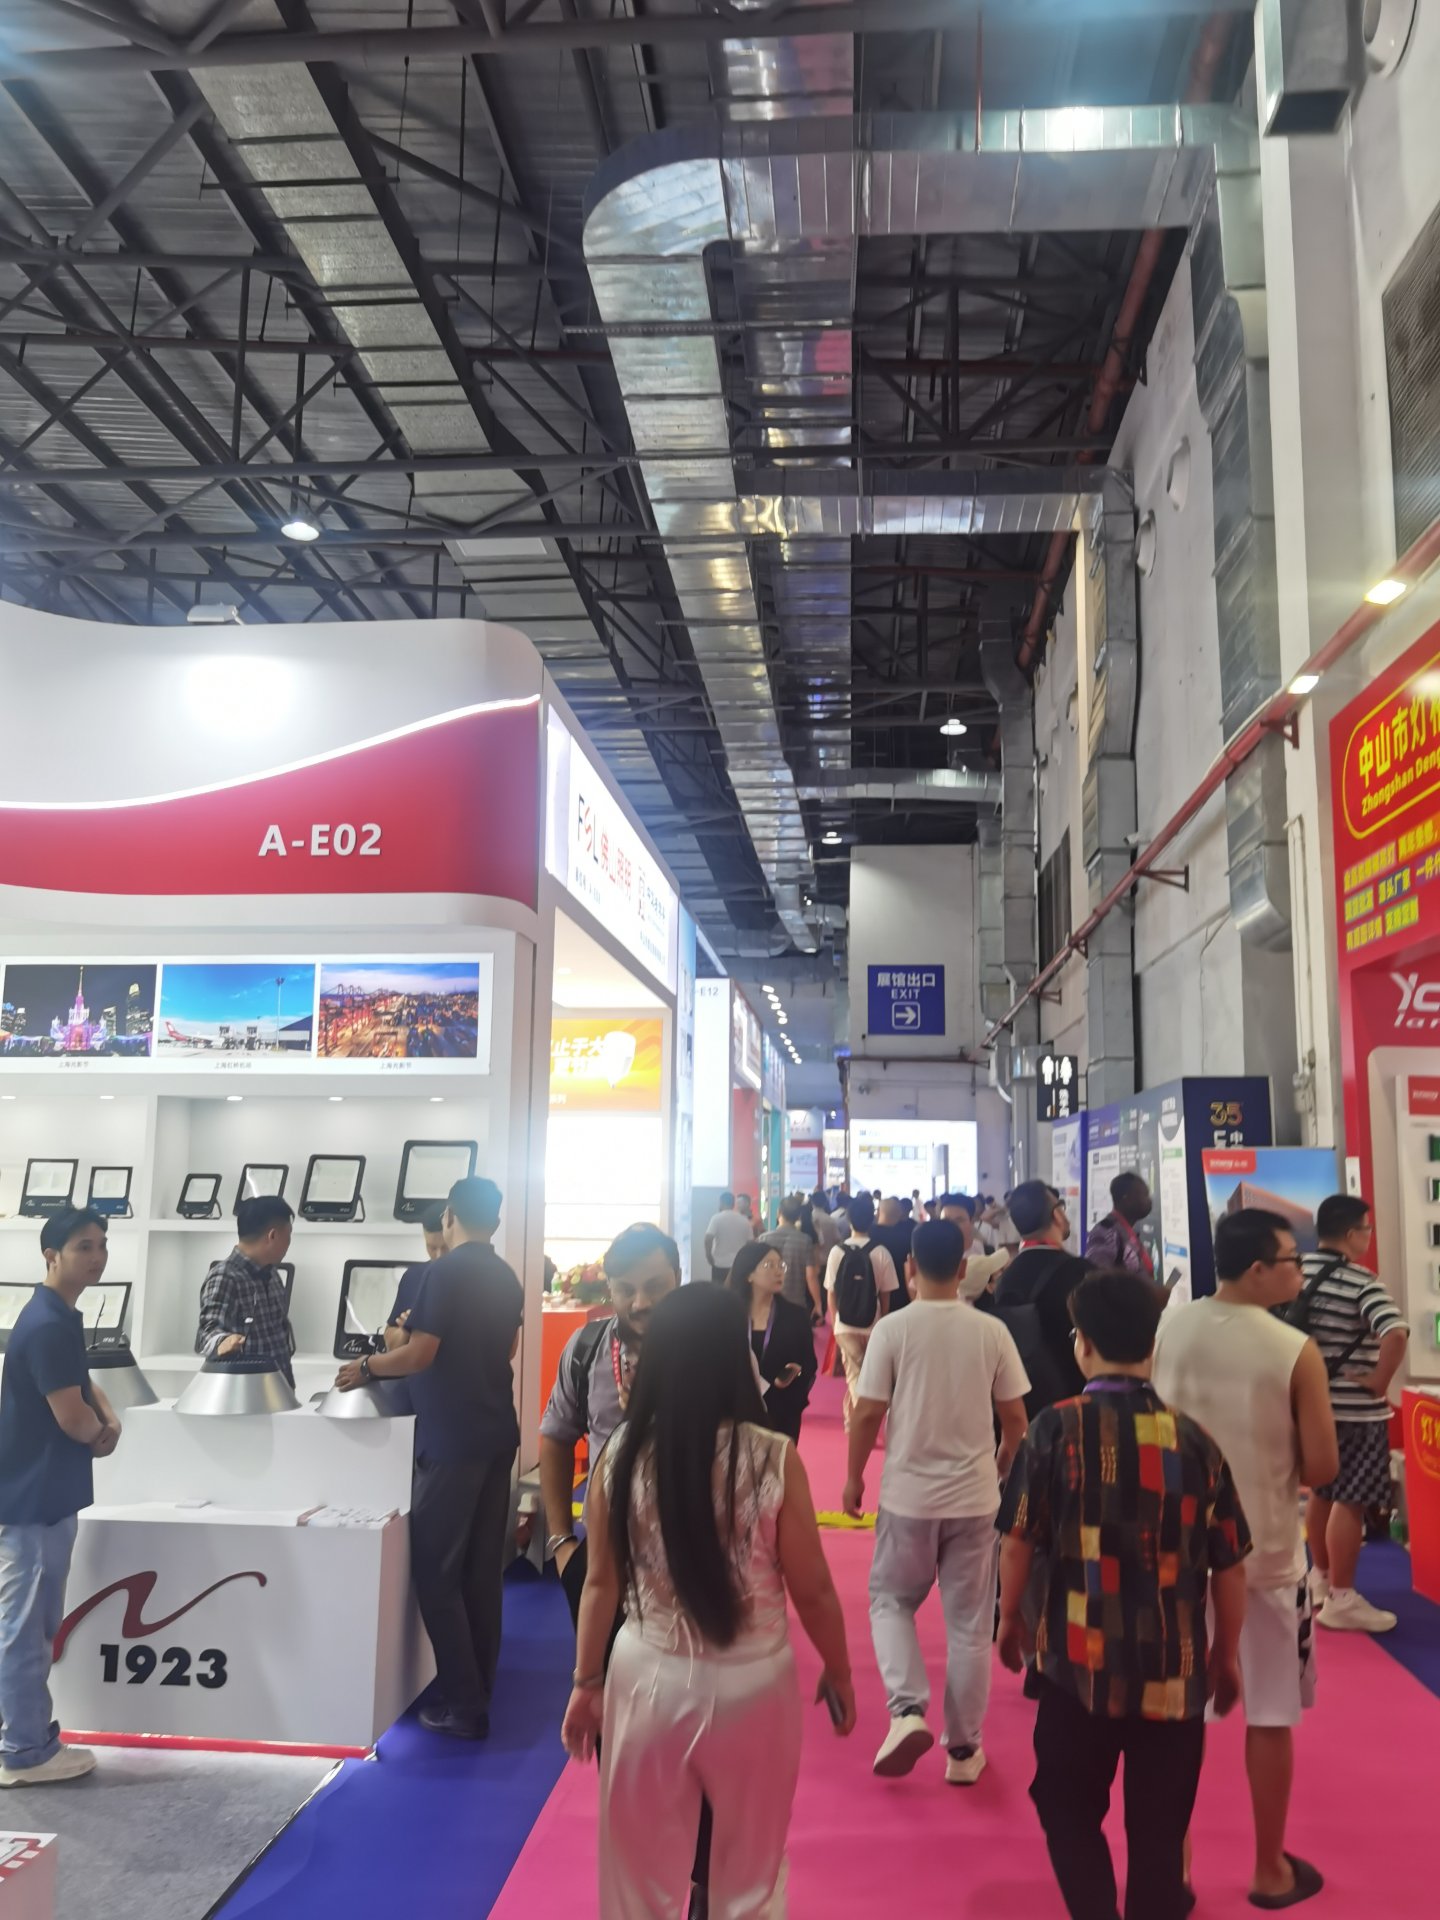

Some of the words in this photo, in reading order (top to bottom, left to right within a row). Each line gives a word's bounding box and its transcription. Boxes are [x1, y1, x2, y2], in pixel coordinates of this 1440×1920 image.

[258, 823, 383, 857] A-E02
[577, 793, 599, 864] FSL
[877, 972, 936, 988] 展馆出口
[891, 989, 920, 999] EXIT
[1210, 1101, 1243, 1127] 35
[100, 1643, 228, 1689] 1923
